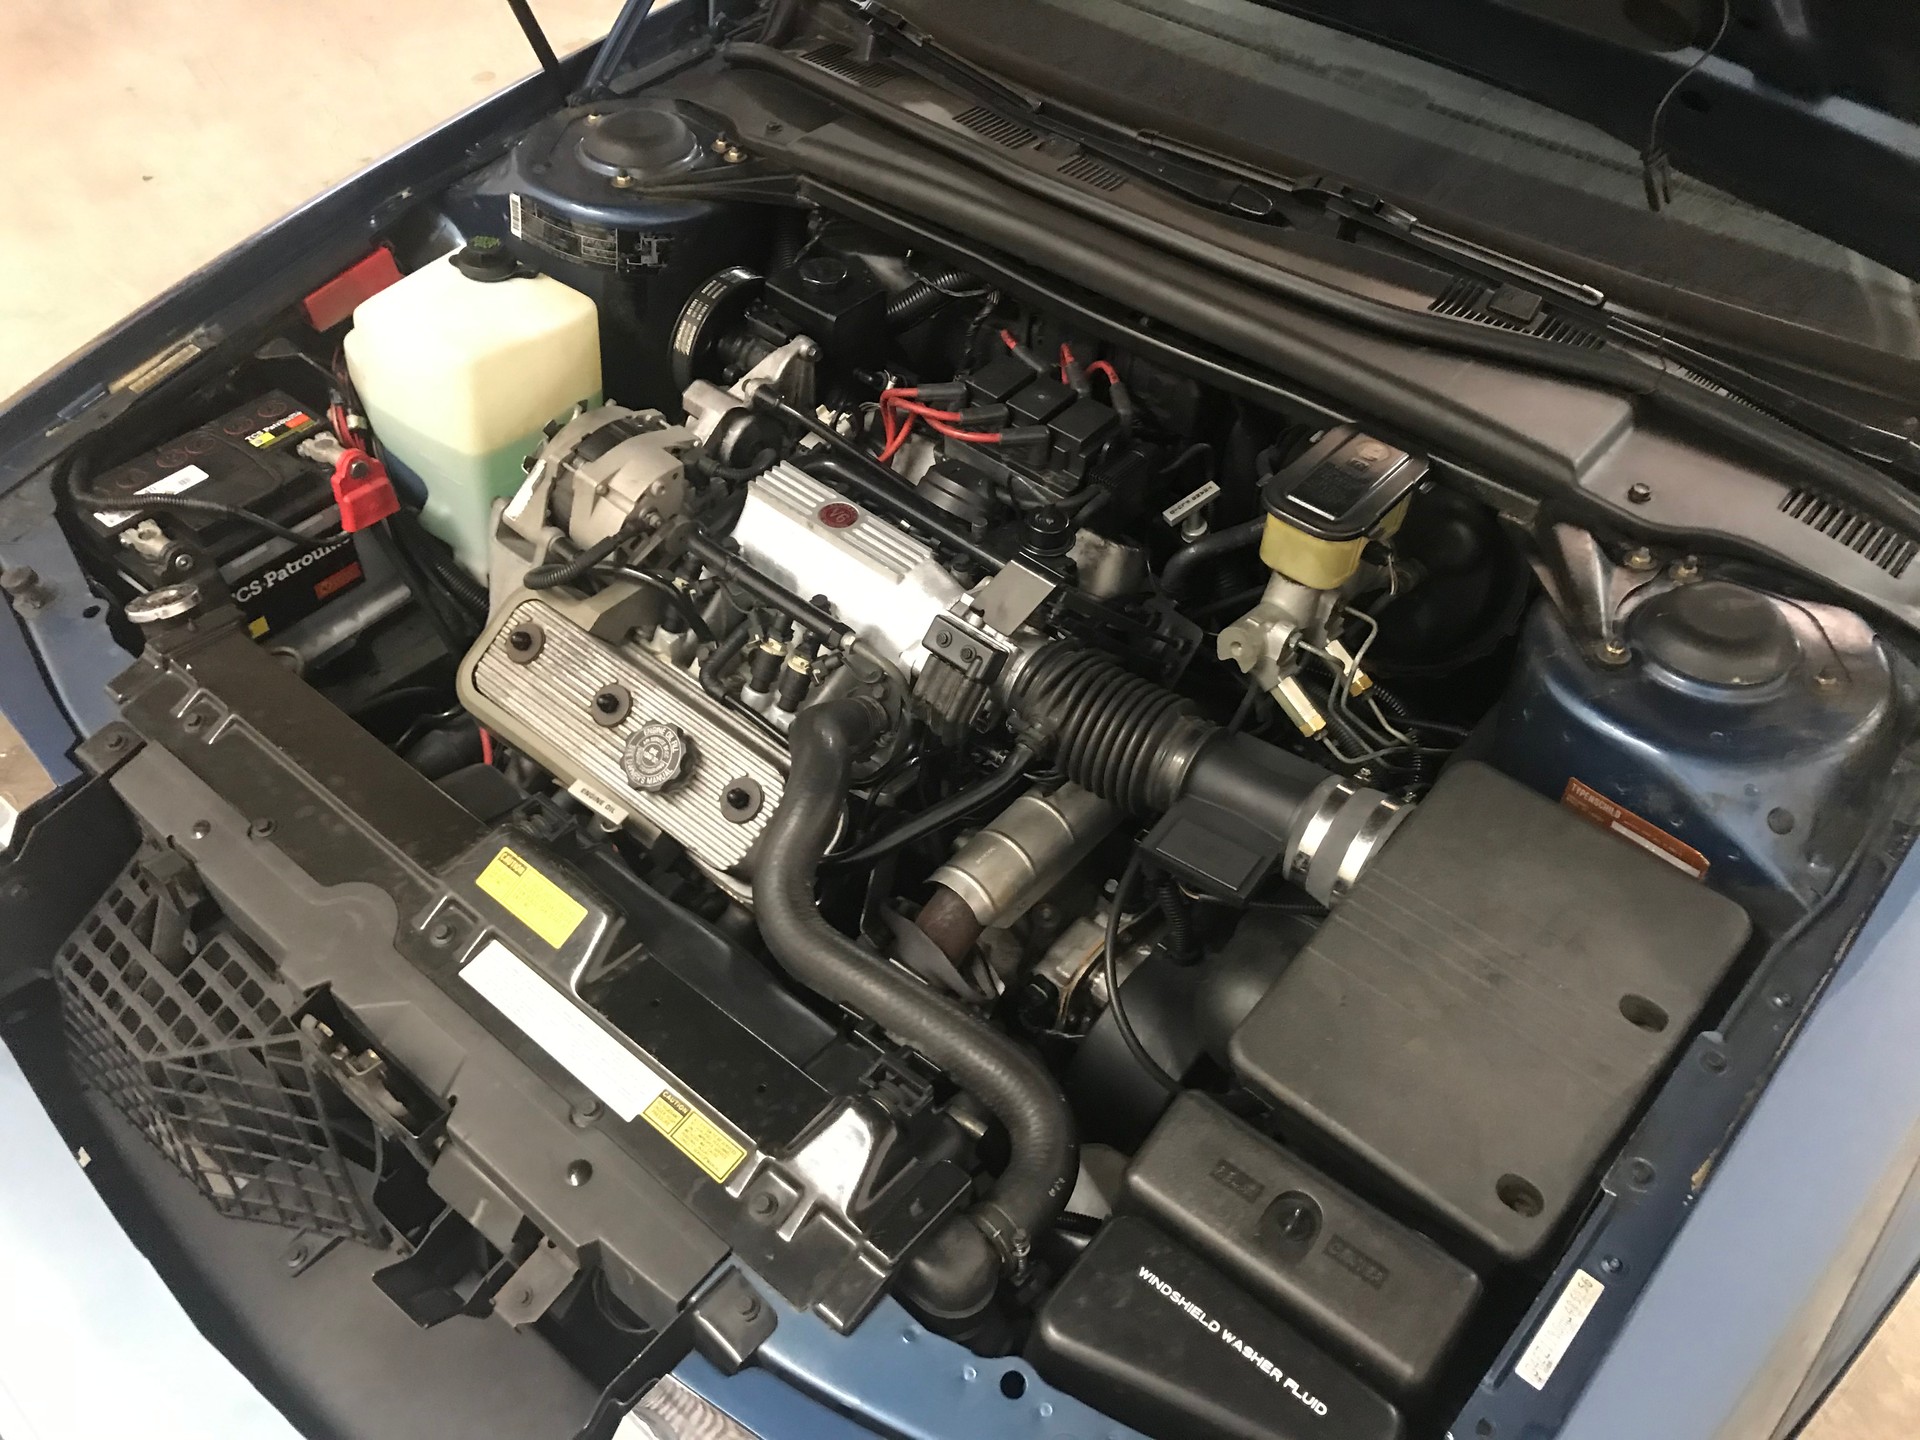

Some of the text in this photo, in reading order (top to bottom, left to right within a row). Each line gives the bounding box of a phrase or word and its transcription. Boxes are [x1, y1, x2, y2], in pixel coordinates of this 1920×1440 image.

[829, 507, 850, 523] V6
[604, 803, 617, 815] OIL
[1570, 783, 1622, 819] TYPENSCHILD
[498, 851, 527, 876] CAUTION
[662, 1091, 690, 1115] CAUTION
[1138, 1266, 1328, 1418] WINDSHIELD WASHER FLUID
